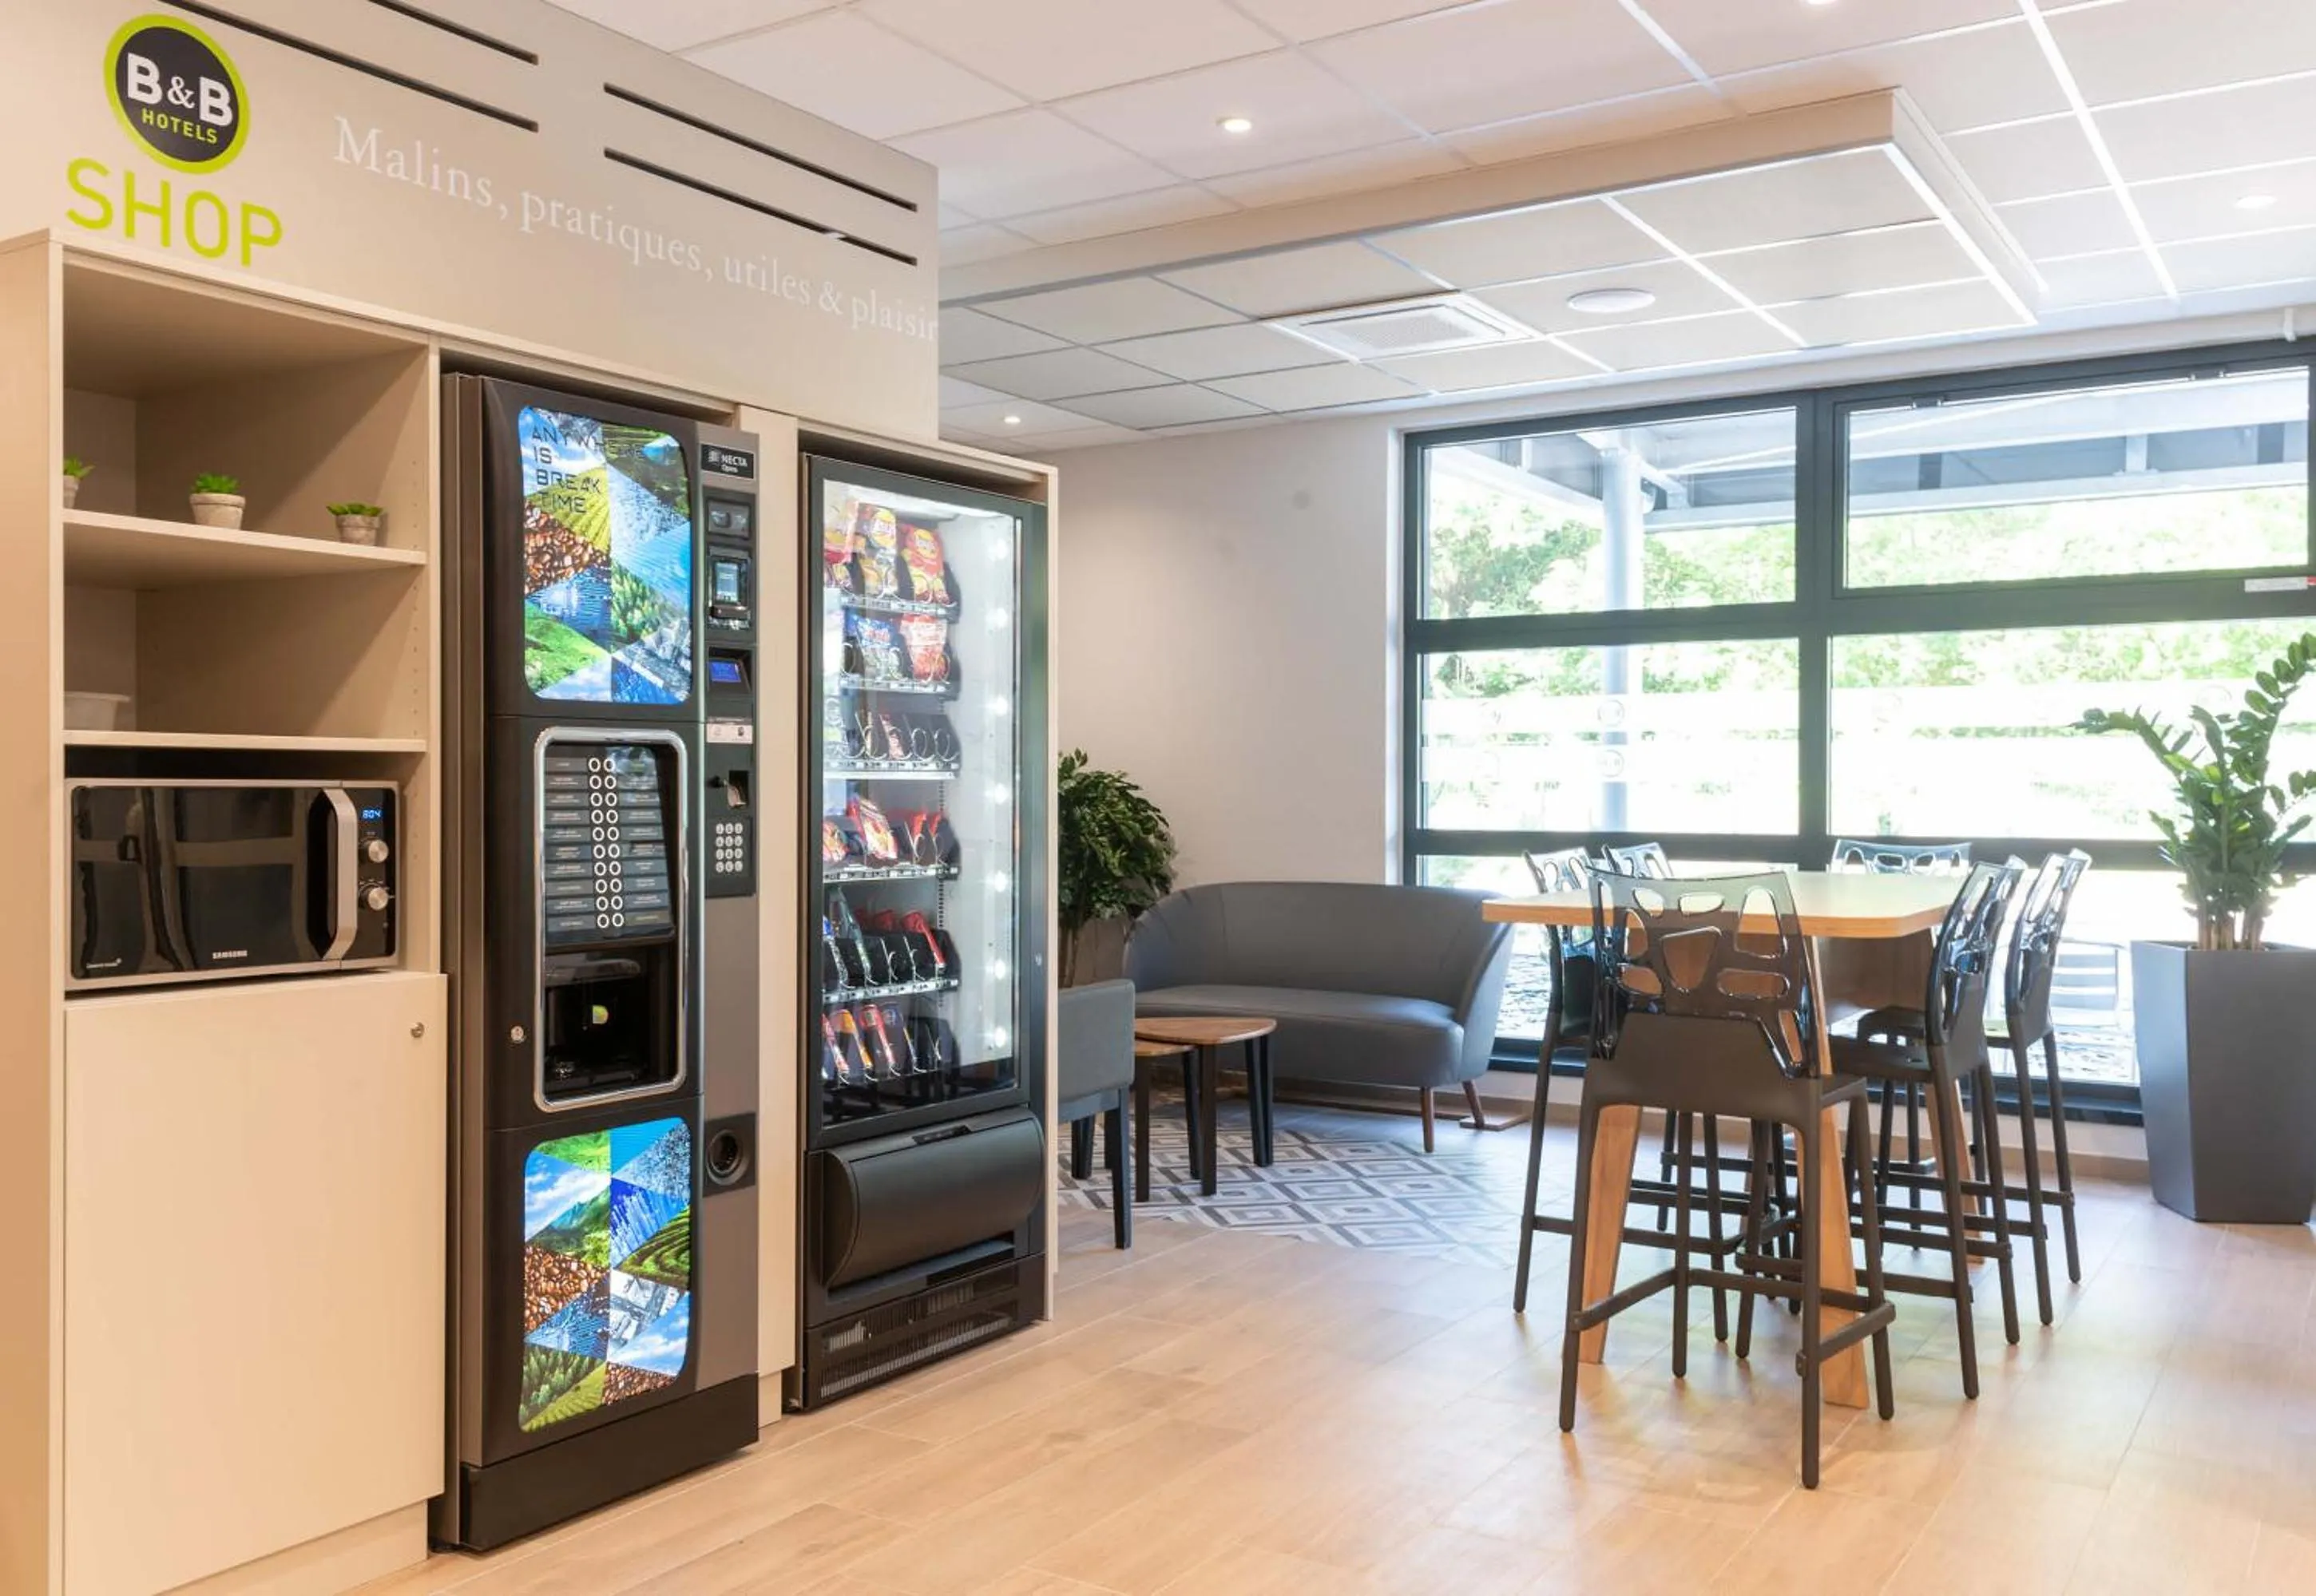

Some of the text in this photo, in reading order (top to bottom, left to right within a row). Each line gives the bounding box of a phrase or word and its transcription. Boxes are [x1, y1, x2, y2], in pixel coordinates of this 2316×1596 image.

[128, 52, 233, 127] B&B
[141, 108, 218, 145] HOTELS
[65, 157, 284, 267] SHOP
[334, 115, 508, 220] Malins,
[519, 188, 715, 283] pratiques,
[723, 255, 812, 305] utiles
[819, 281, 843, 315] &
[532, 426, 645, 460] ANYWHERE
[533, 446, 553, 465] IS
[536, 469, 601, 496] BREAK
[538, 490, 587, 514] TIME
